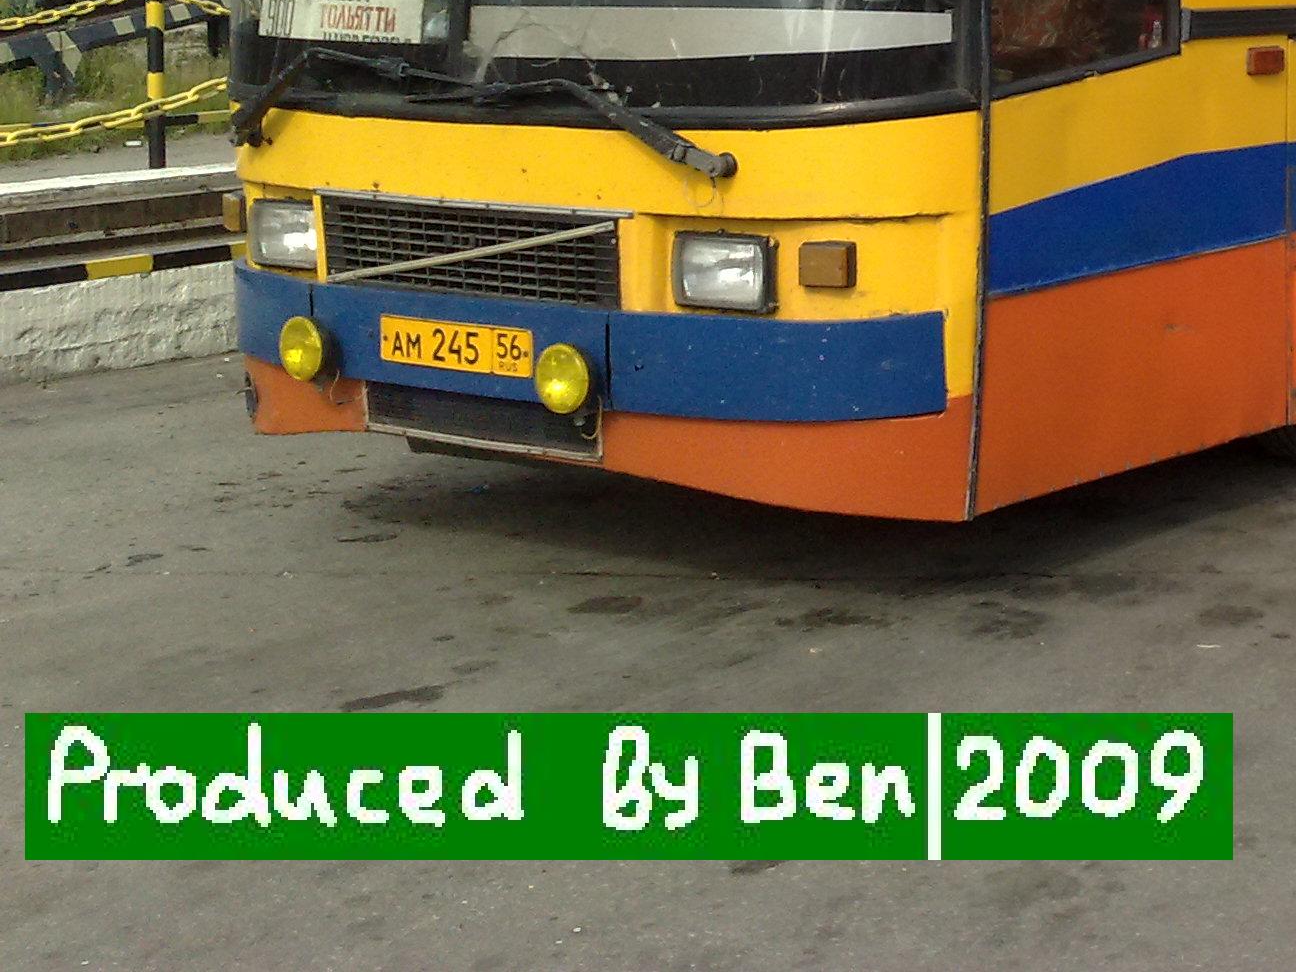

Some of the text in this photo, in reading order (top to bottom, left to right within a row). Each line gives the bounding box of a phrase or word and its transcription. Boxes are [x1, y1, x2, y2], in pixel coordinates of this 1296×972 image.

[320, 4, 397, 33] ТОЛЬЯТТИ
[432, 328, 480, 365] 245
[496, 333, 522, 361] 56
[498, 361, 518, 373] RUS
